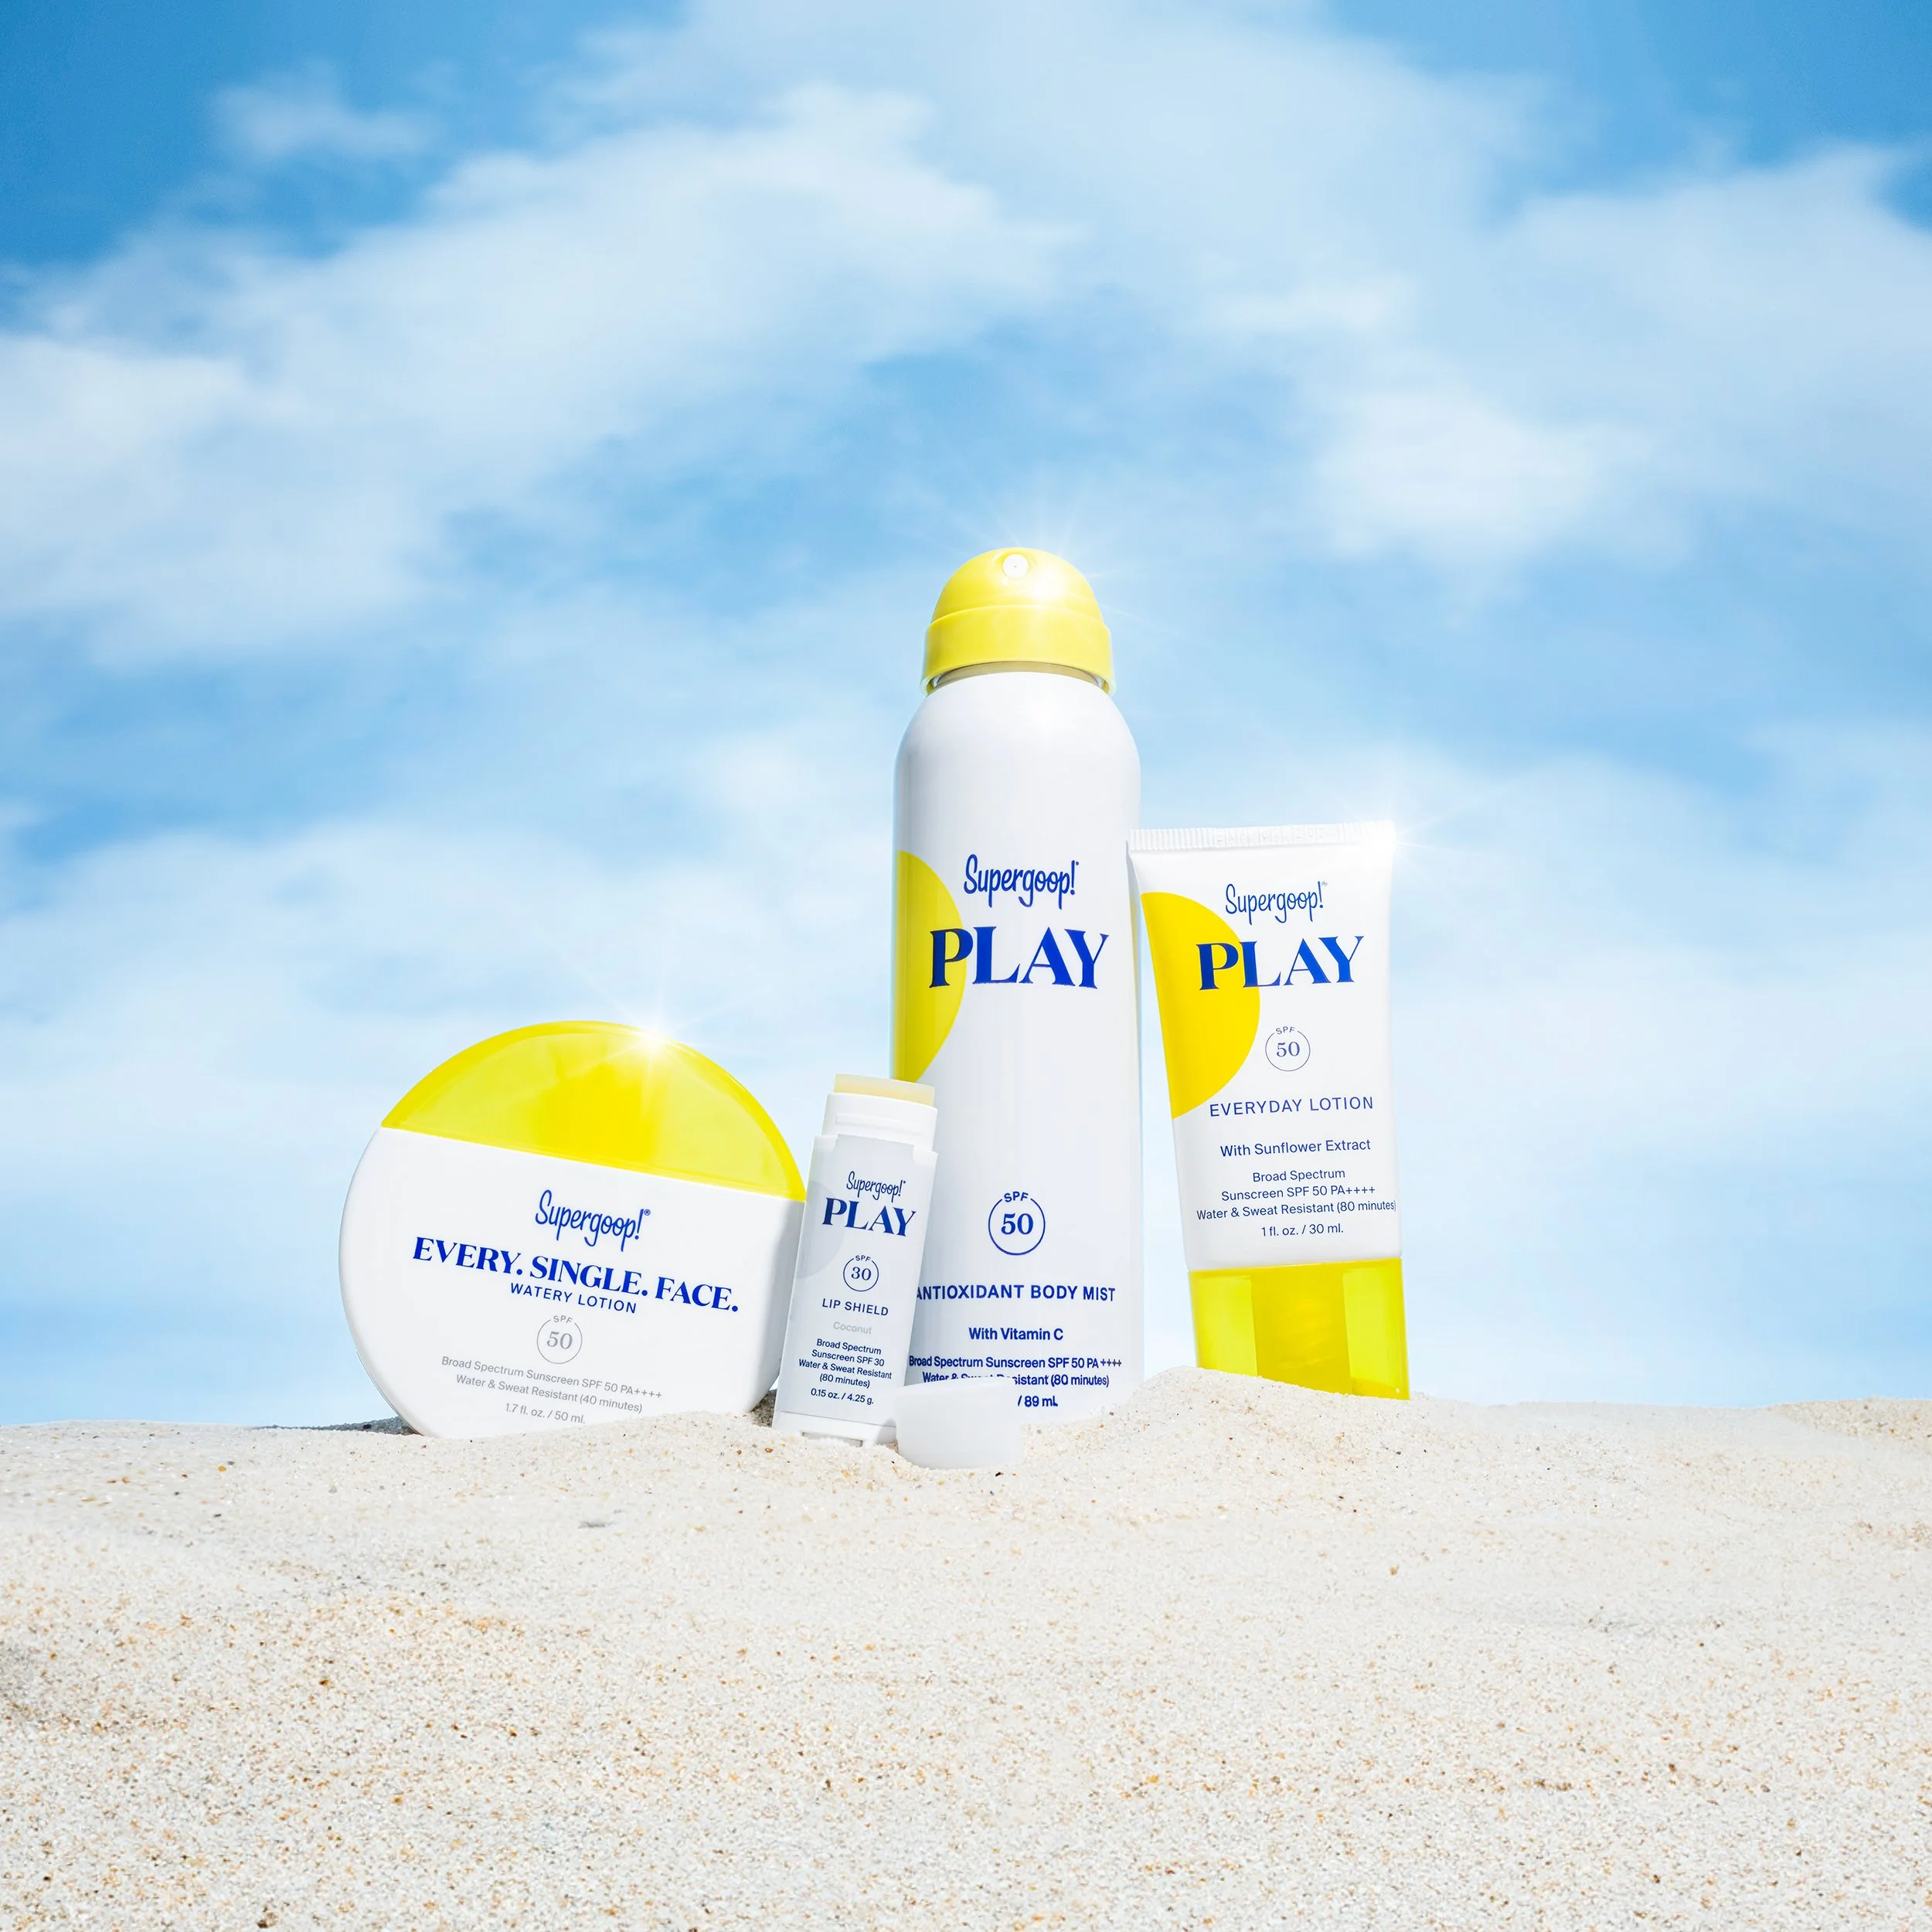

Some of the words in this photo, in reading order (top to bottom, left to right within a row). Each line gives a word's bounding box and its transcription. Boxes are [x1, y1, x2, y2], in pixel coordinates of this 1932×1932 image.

[929, 927, 1109, 989] PLAY
[1196, 936, 1364, 991] PLAY
[1276, 1026, 1294, 1035] SPF
[1277, 1042, 1300, 1057] 50
[1210, 1099, 1301, 1117] EVERYDAY
[1310, 1097, 1372, 1111] LOTION
[1220, 1145, 1250, 1157] With
[1254, 1142, 1321, 1155] Sunflower
[1325, 1140, 1371, 1151] Extract
[1253, 1171, 1287, 1182] Broad
[1290, 1170, 1345, 1182] Spectrum
[1004, 1191, 1029, 1202] SPF
[1222, 1190, 1284, 1201] Sunscreen
[1287, 1186, 1309, 1197] SPF
[1313, 1185, 1327, 1196] 50
[822, 1197, 916, 1236] PLAY
[1196, 1209, 1228, 1219] Water
[1231, 1207, 1240, 1217] &
[1243, 1206, 1277, 1216] Sweat
[1281, 1203, 1334, 1214] Resistant
[1337, 1201, 1355, 1213] (80
[1358, 1201, 1396, 1211] minutes)
[1001, 1213, 1033, 1235] 50
[1262, 1227, 1266, 1236] 1
[1269, 1226, 1279, 1236] fl.
[1301, 1225, 1306, 1234] /
[1309, 1223, 1324, 1234] 30
[1328, 1223, 1343, 1233] ml.
[413, 1236, 522, 1275] EVERY.
[530, 1255, 648, 1296] SINGLE.
[655, 1277, 738, 1312] FACE.
[851, 1267, 871, 1281] 30
[511, 1283, 573, 1302] WATERY
[578, 1294, 636, 1314] LOTION
[917, 1284, 1024, 1300] ANTIOXIDANT
[1031, 1285, 1077, 1300] BODY
[1083, 1286, 1115, 1301] MIST
[822, 1298, 841, 1308] LIP
[845, 1301, 888, 1316] SHIELD
[833, 1321, 872, 1334] Coconut
[969, 1328, 998, 1340] With
[1000, 1328, 1050, 1340] Vitamin
[1053, 1328, 1063, 1341] C
[546, 1331, 573, 1349] 50
[817, 1338, 841, 1349] Broad
[842, 1342, 881, 1355] Spectrum
[811, 1349, 855, 1362] Sunscreen
[856, 1355, 872, 1364] SPF
[874, 1358, 884, 1366] 30
[909, 1355, 932, 1366] Broad
[934, 1355, 983, 1369] Spectrum
[985, 1356, 1046, 1368] Sunscreen
[1048, 1357, 1070, 1368] SPF
[1071, 1358, 1084, 1369] 50
[442, 1356, 472, 1369] Broad
[474, 1361, 524, 1377] Spectrum
[526, 1369, 579, 1386] Sunscreen
[582, 1379, 603, 1389] SPF
[604, 1382, 618, 1393] 50
[799, 1359, 821, 1369] Water
[830, 1363, 855, 1373] Sweat
[857, 1367, 892, 1379] Resistant
[820, 1373, 834, 1382] (80
[835, 1376, 870, 1389] minutes)
[1051, 1374, 1068, 1387] (80
[1071, 1375, 1109, 1388] minutes)
[457, 1374, 486, 1386] Water
[488, 1379, 495, 1389] &
[498, 1381, 529, 1394] Sweat
[532, 1386, 578, 1402] Resistant
[580, 1394, 597, 1405] (40
[599, 1399, 642, 1414] minutes)
[811, 1388, 826, 1397] 0.15
[847, 1393, 866, 1403] 4.25
[1018, 1395, 1022, 1406] /
[1024, 1396, 1039, 1407] 89
[506, 1403, 519, 1413] 1.7
[531, 1409, 545, 1417] oz.
[547, 1410, 553, 1418] /
[554, 1410, 568, 1421] 50
[570, 1415, 585, 1423] ml.
